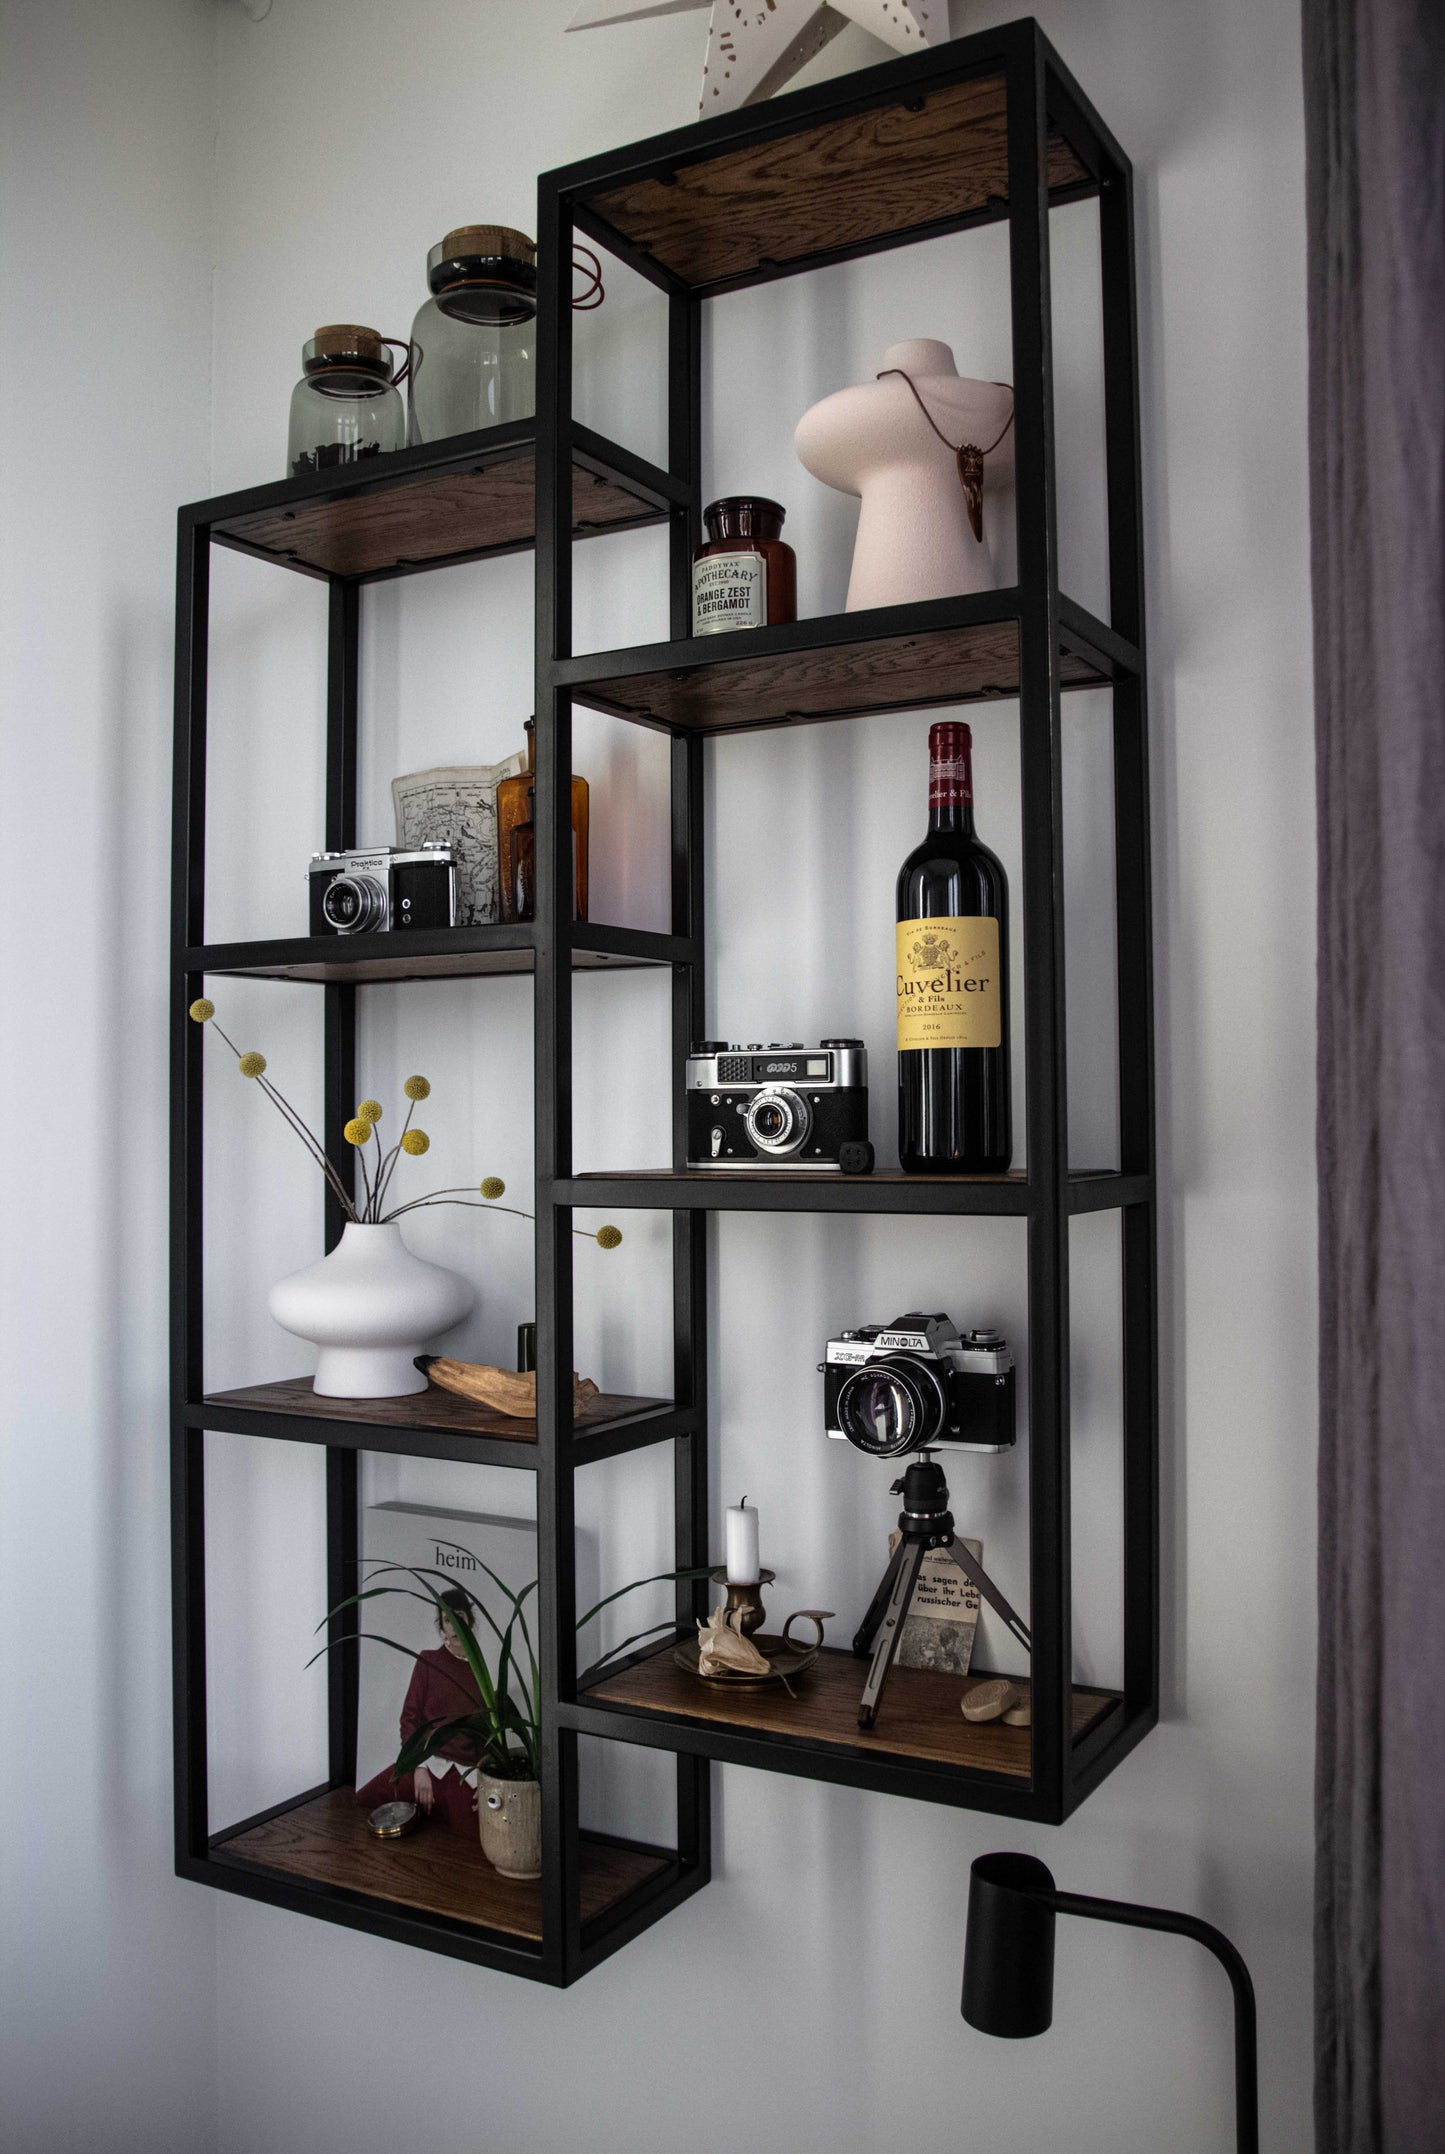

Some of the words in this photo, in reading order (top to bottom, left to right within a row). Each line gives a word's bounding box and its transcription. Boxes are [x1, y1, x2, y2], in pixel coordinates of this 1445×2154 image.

[702, 562, 740, 572] PADDYWAX
[695, 569, 758, 590] APOTHECARY
[697, 588, 725, 605] ORANGE
[728, 587, 751, 598] ZEST
[703, 598, 750, 614] BERGAMOT
[351, 859, 382, 868] Praktica
[897, 969, 989, 996] Cuvelier
[907, 1004, 962, 1013] BORDEAUX
[881, 1337, 923, 1347] MINOLTA
[834, 1352, 865, 1362] XG-M
[435, 1546, 477, 1570] heim
[933, 1576, 958, 1585] sagen
[918, 1583, 937, 1593] über
[943, 1587, 955, 1595] ihr
[917, 1596, 960, 1607] russischer
